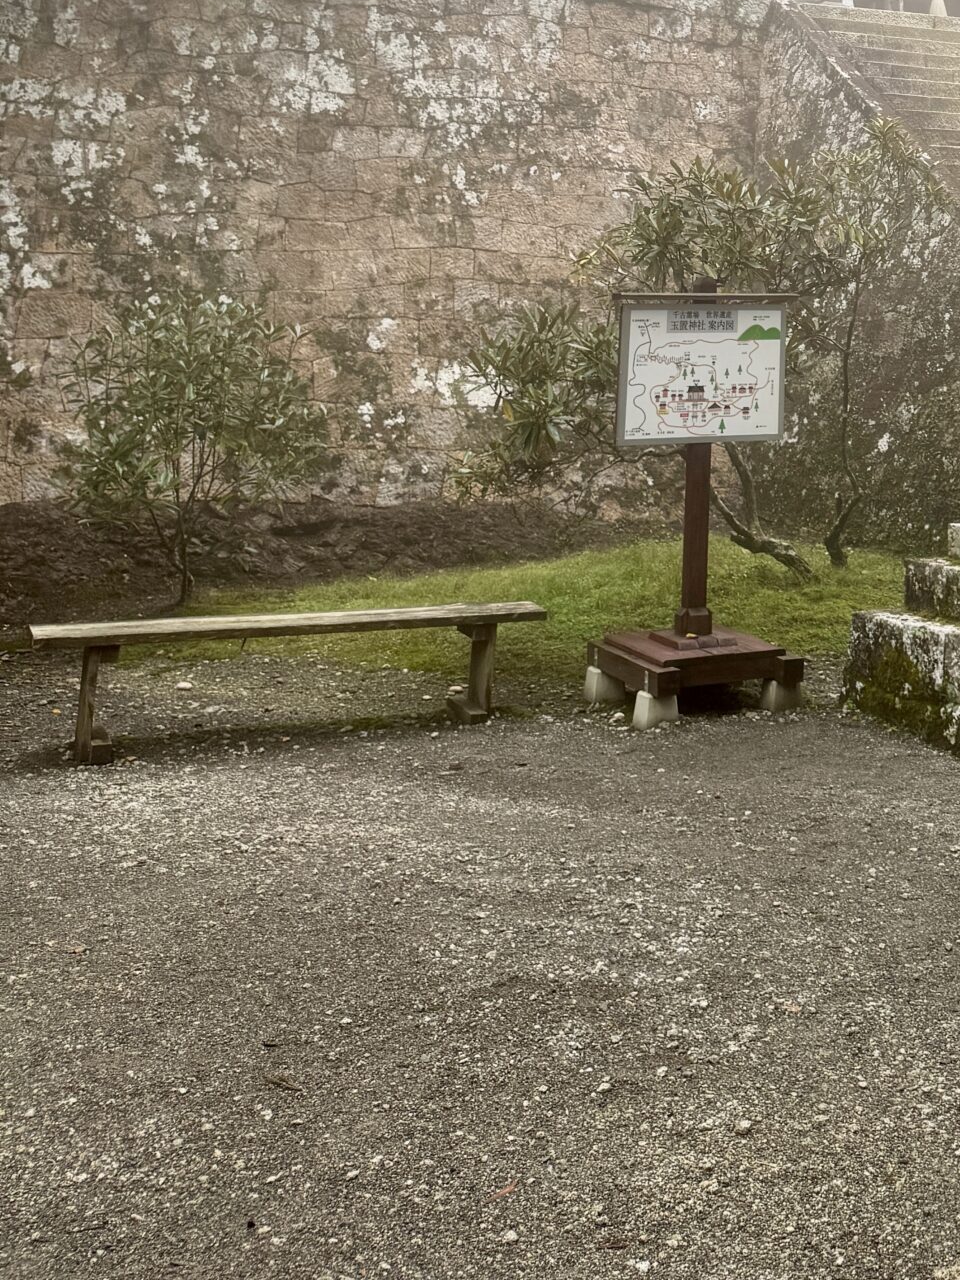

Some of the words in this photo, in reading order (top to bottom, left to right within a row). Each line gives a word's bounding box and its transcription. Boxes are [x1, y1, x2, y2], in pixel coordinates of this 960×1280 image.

[670, 320, 706, 331] 玉置神社
[708, 320, 734, 331] 案内図
